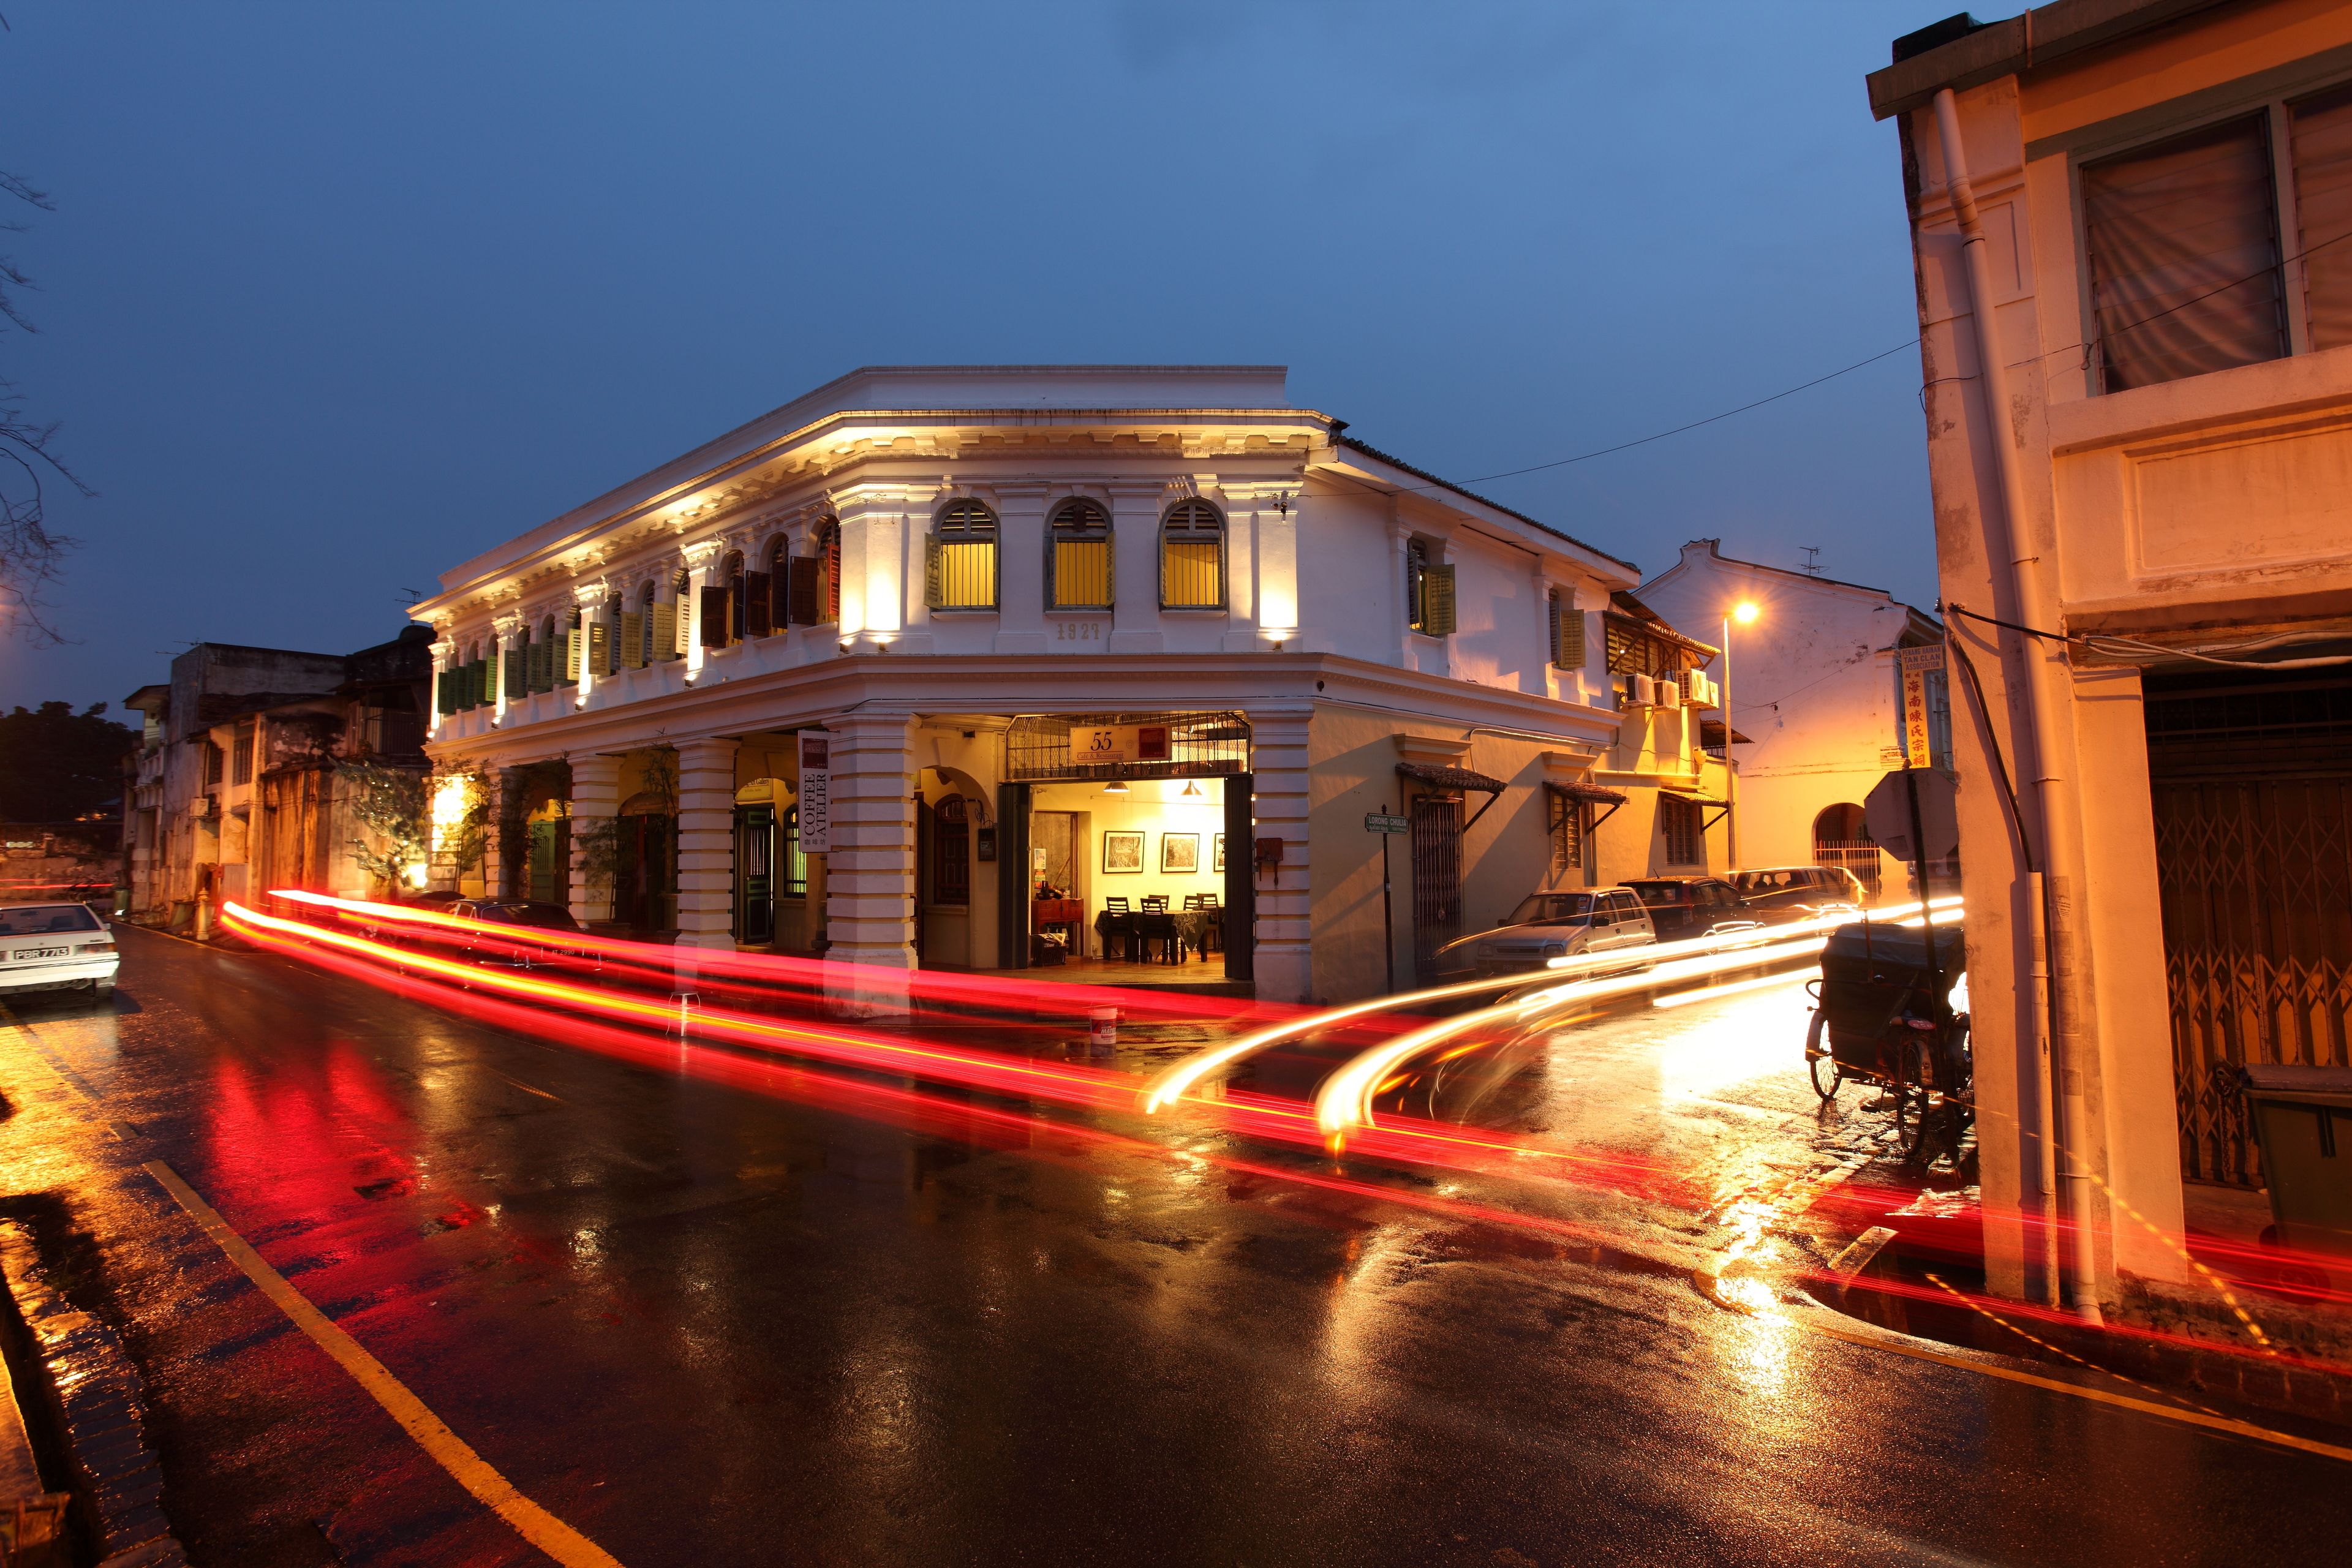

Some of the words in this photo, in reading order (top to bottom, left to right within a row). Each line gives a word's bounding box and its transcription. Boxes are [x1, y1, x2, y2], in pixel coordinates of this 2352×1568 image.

[1902, 648, 1921, 657] PENANG
[1920, 653, 1940, 662] CLAN
[1905, 661, 1940, 671] ASSOCIATION
[1907, 680, 1926, 766] 海南陳氏宗祠
[1090, 731, 1112, 751] 55
[804, 774, 815, 836] COFFEE
[816, 774, 826, 837] ATELIER
[1368, 816, 1388, 825] LORONG
[1390, 818, 1407, 827] CHULIA
